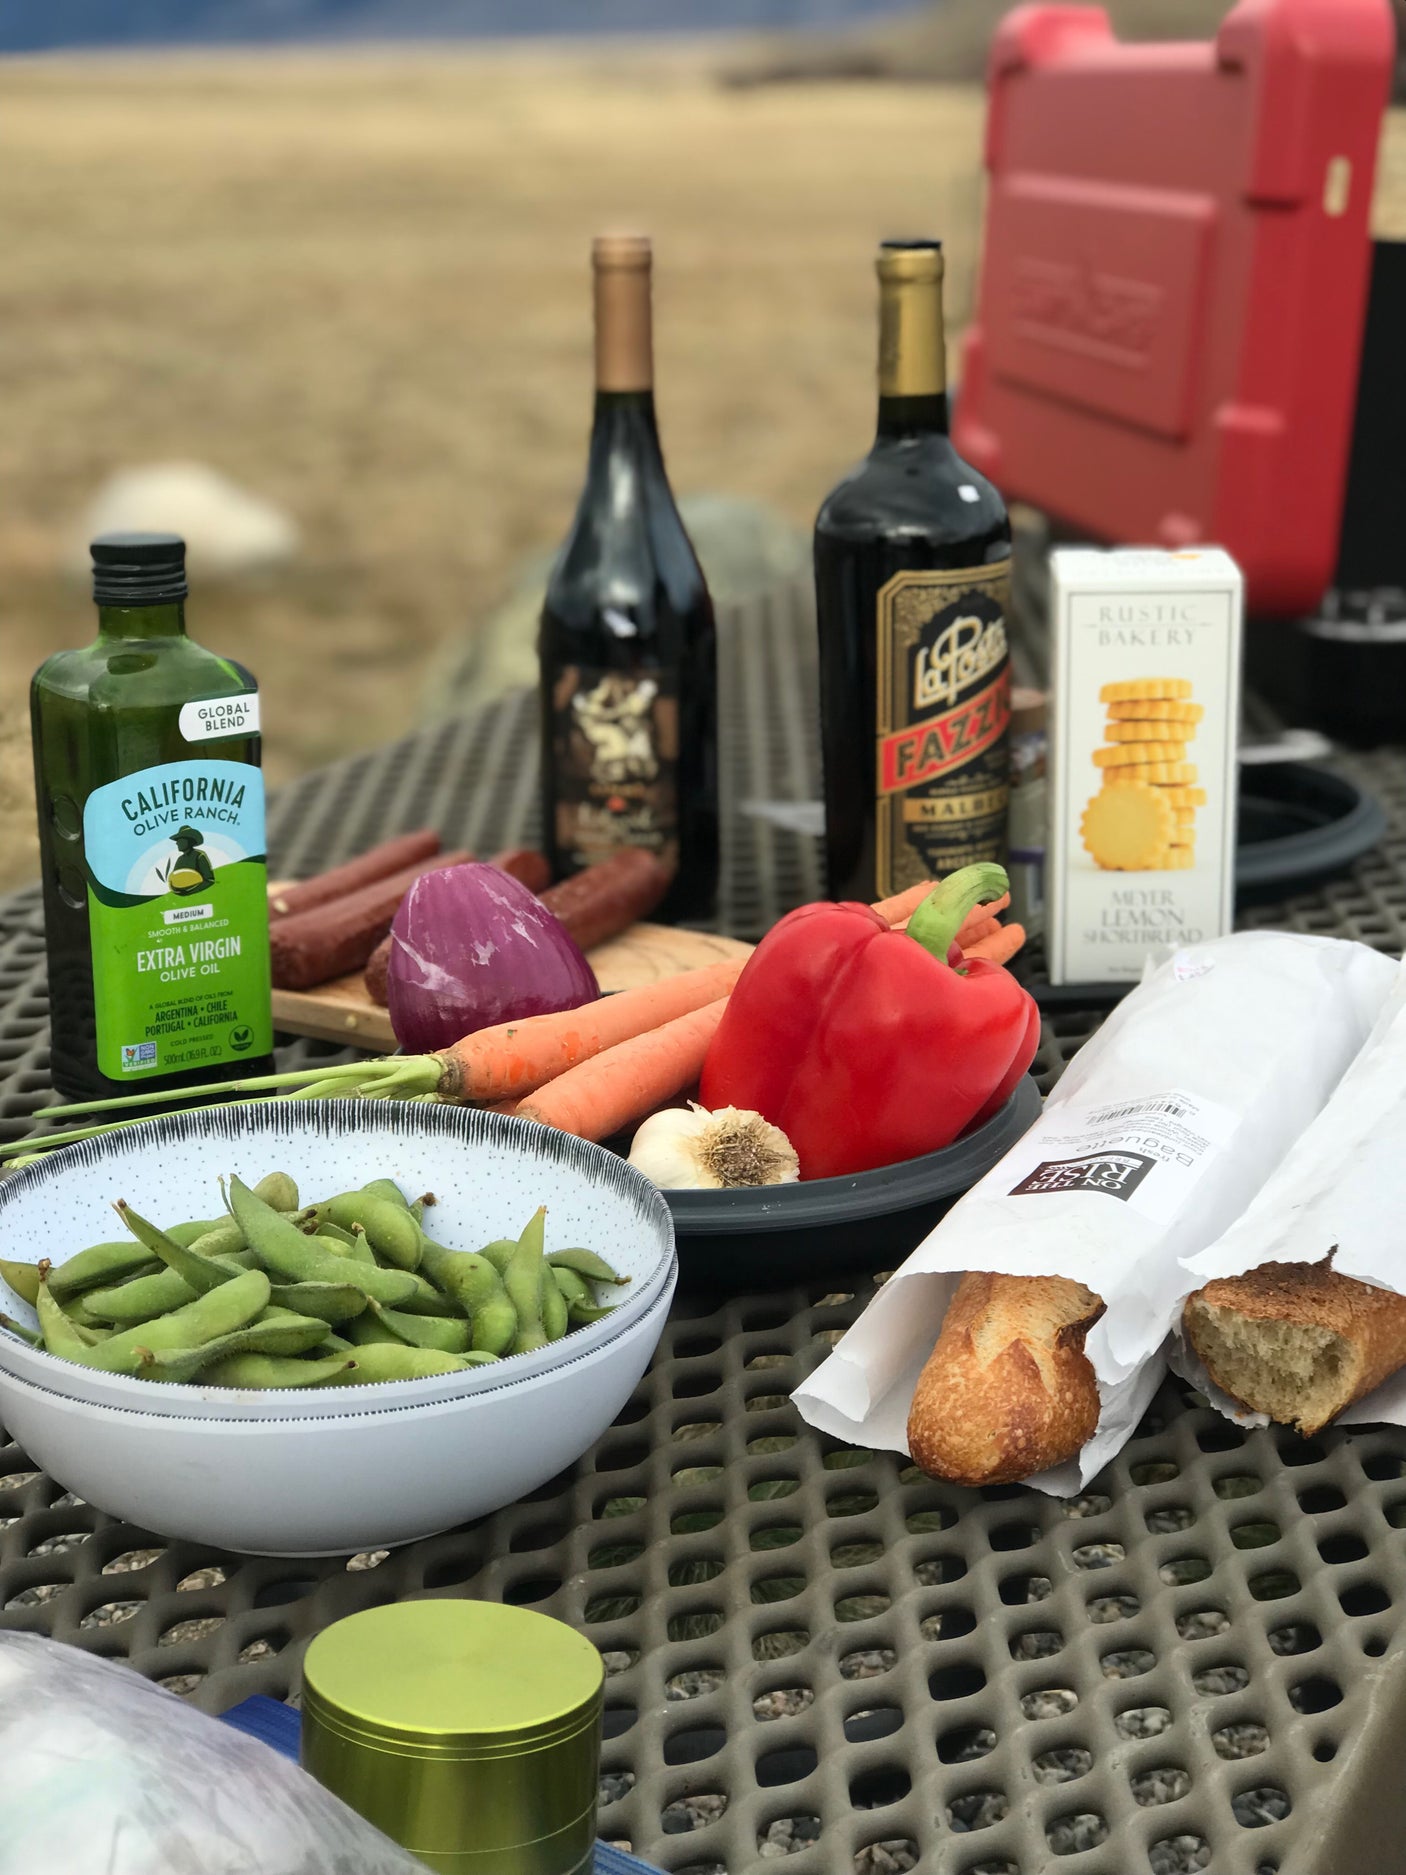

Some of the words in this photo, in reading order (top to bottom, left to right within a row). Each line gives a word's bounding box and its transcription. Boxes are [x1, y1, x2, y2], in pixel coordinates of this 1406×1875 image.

[1099, 605, 1198, 622] RUSTIC
[1098, 629, 1195, 646] BAKERY
[198, 702, 250, 719] GLOBAL
[205, 715, 245, 732] BLEND
[121, 777, 246, 822] CALIFORNIA
[133, 808, 180, 837] OLIVE
[184, 806, 239, 826] RANCH
[1111, 889, 1175, 907] MEYER
[173, 908, 204, 921] MEDIUM
[1101, 908, 1185, 928] LEMON
[147, 926, 182, 939] SMOOTH
[189, 918, 229, 933] BALANCED
[1082, 928, 1204, 945] SHORTBREAD
[137, 946, 185, 973] EXTRA
[189, 935, 242, 964] VIRGIN
[160, 966, 196, 983] OLIVE
[200, 962, 221, 976] OIL
[154, 1000, 177, 1009] GLOBAL
[155, 1005, 198, 1023] ARGENTINA
[206, 999, 228, 1013] CHILE
[145, 1020, 185, 1037] PORTUGAL
[193, 1010, 238, 1028] CALIFORNIA
[170, 1039, 187, 1047] COLD
[1075, 1135, 1195, 1168] Baguette
[1138, 1146, 1171, 1163] fresh
[1038, 1161, 1139, 1184] RISE
[1025, 1176, 1075, 1191] THE
[1081, 1177, 1123, 1190] ON
